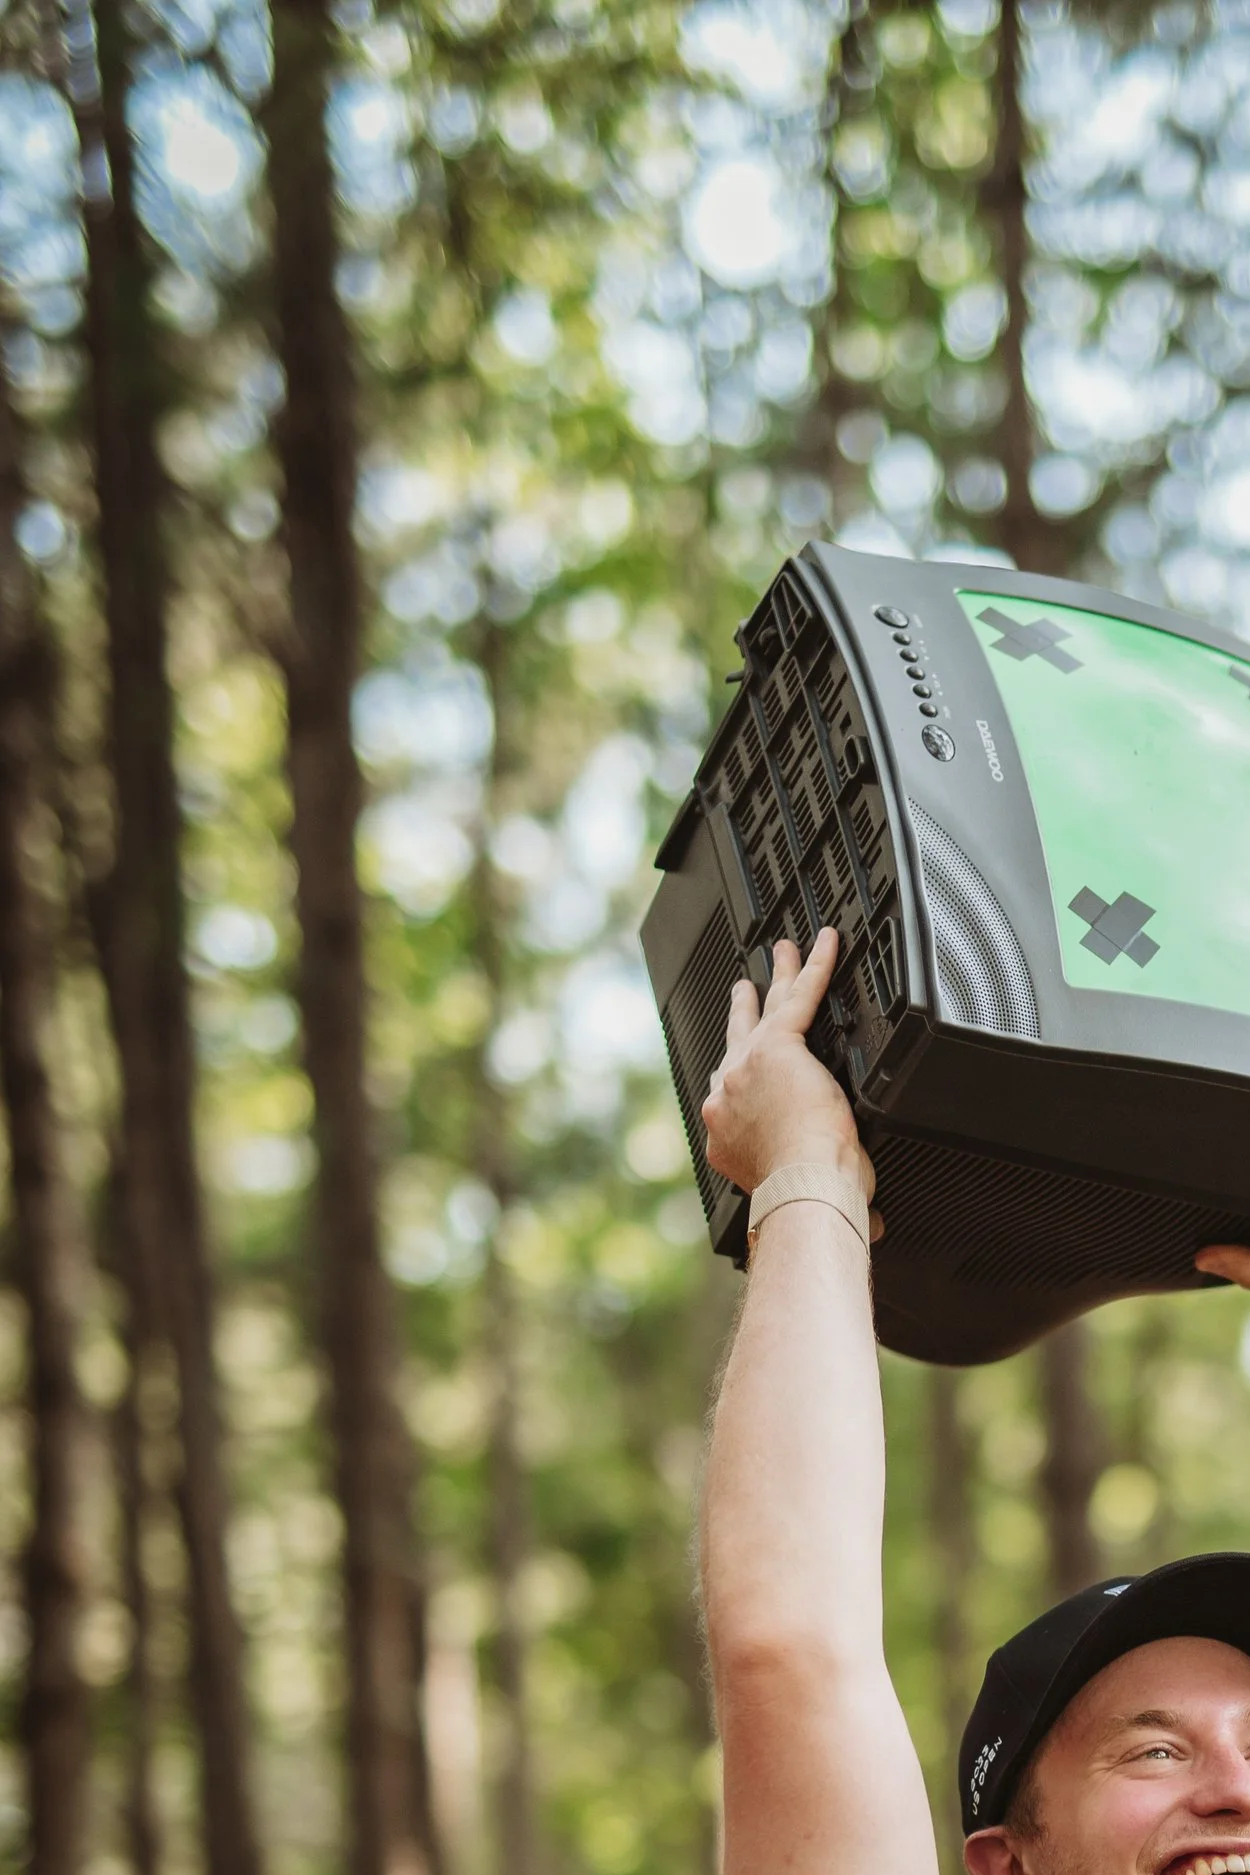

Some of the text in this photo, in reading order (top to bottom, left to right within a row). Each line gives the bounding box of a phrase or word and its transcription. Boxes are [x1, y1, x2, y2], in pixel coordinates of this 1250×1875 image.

[976, 719, 1004, 782] DAEWOO
[972, 1736, 1003, 1816] US OPEN
